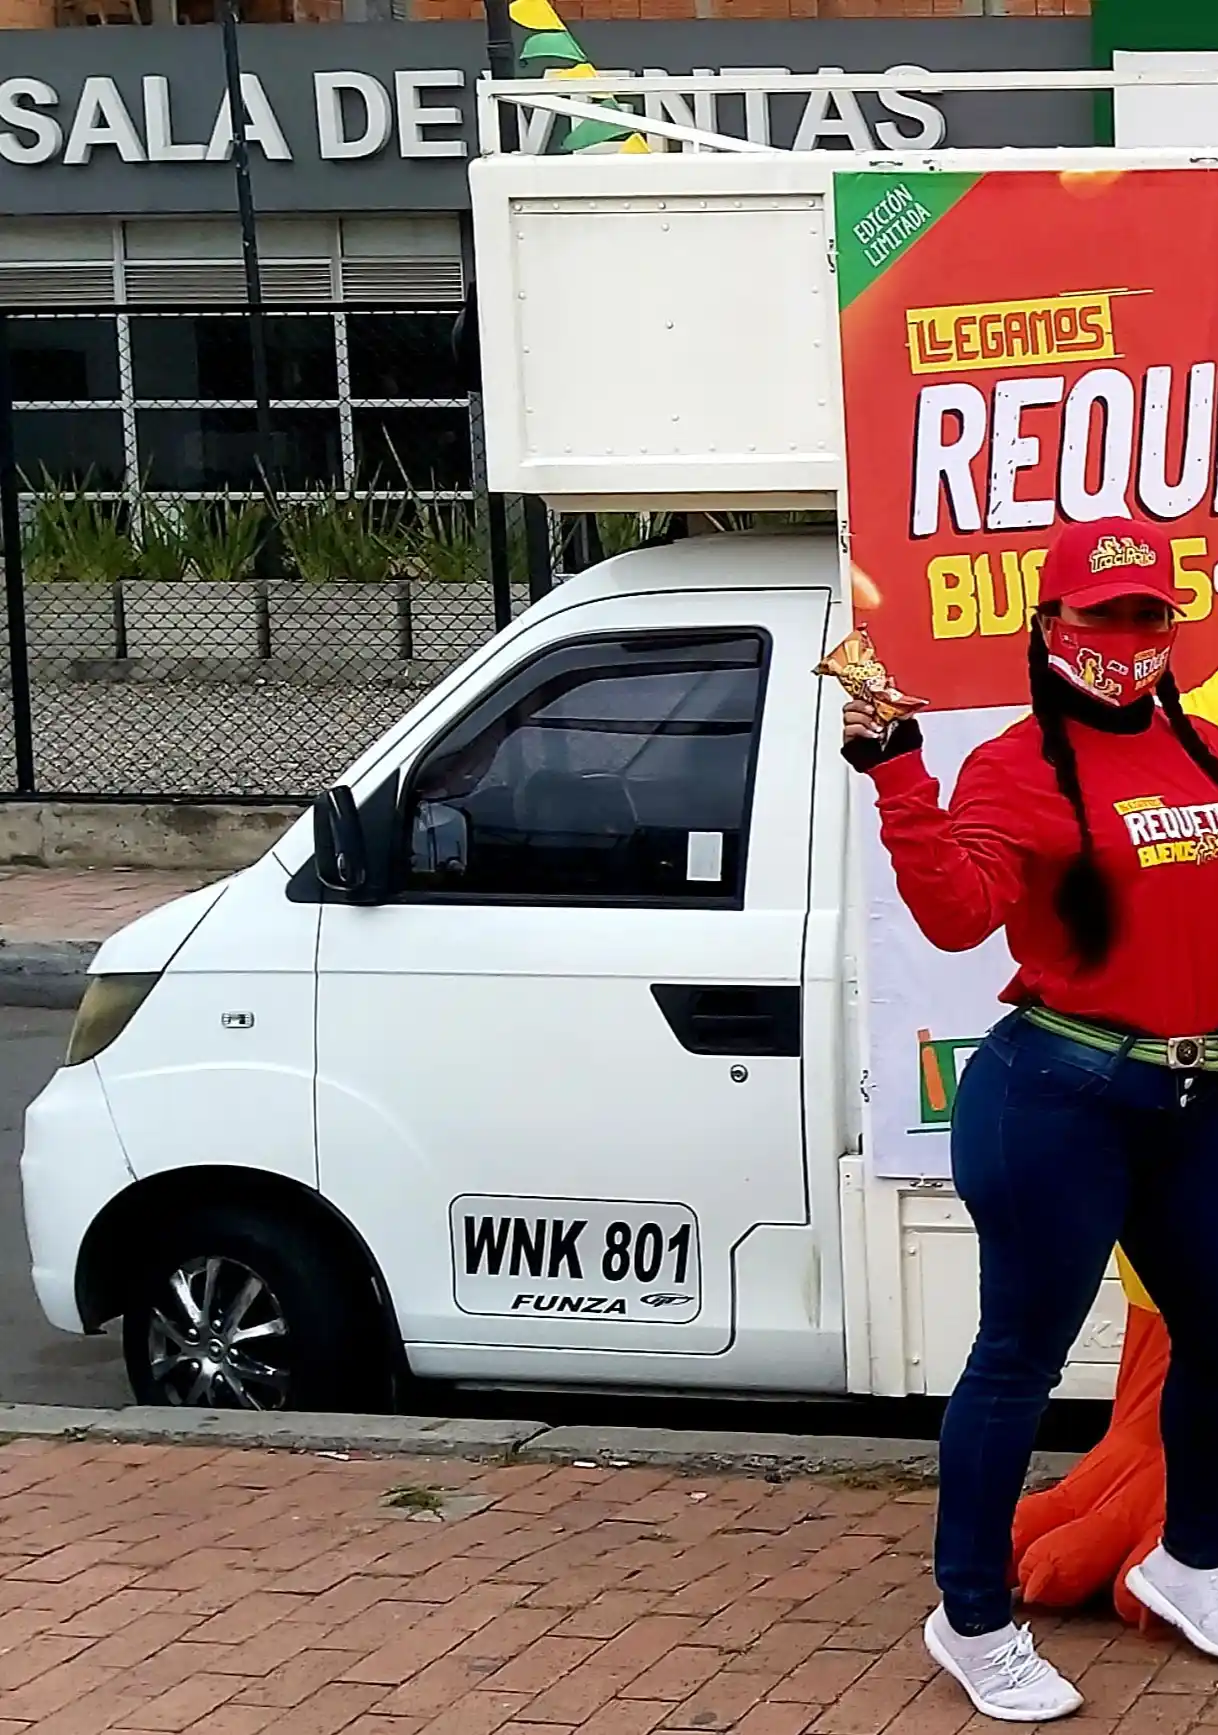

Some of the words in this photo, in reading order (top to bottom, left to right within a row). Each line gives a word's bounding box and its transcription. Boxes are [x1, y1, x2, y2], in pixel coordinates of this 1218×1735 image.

[0, 71, 292, 164] SALA
[316, 69, 467, 161] DE
[853, 183, 914, 245] EDICIÓN
[863, 201, 932, 268] LIMITADA
[915, 305, 1105, 366] LLEGAMOS
[927, 536, 1214, 641] BUS
[464, 1215, 589, 1280] WNK
[602, 1220, 692, 1284] 801
[510, 1293, 627, 1315] FUNZA
